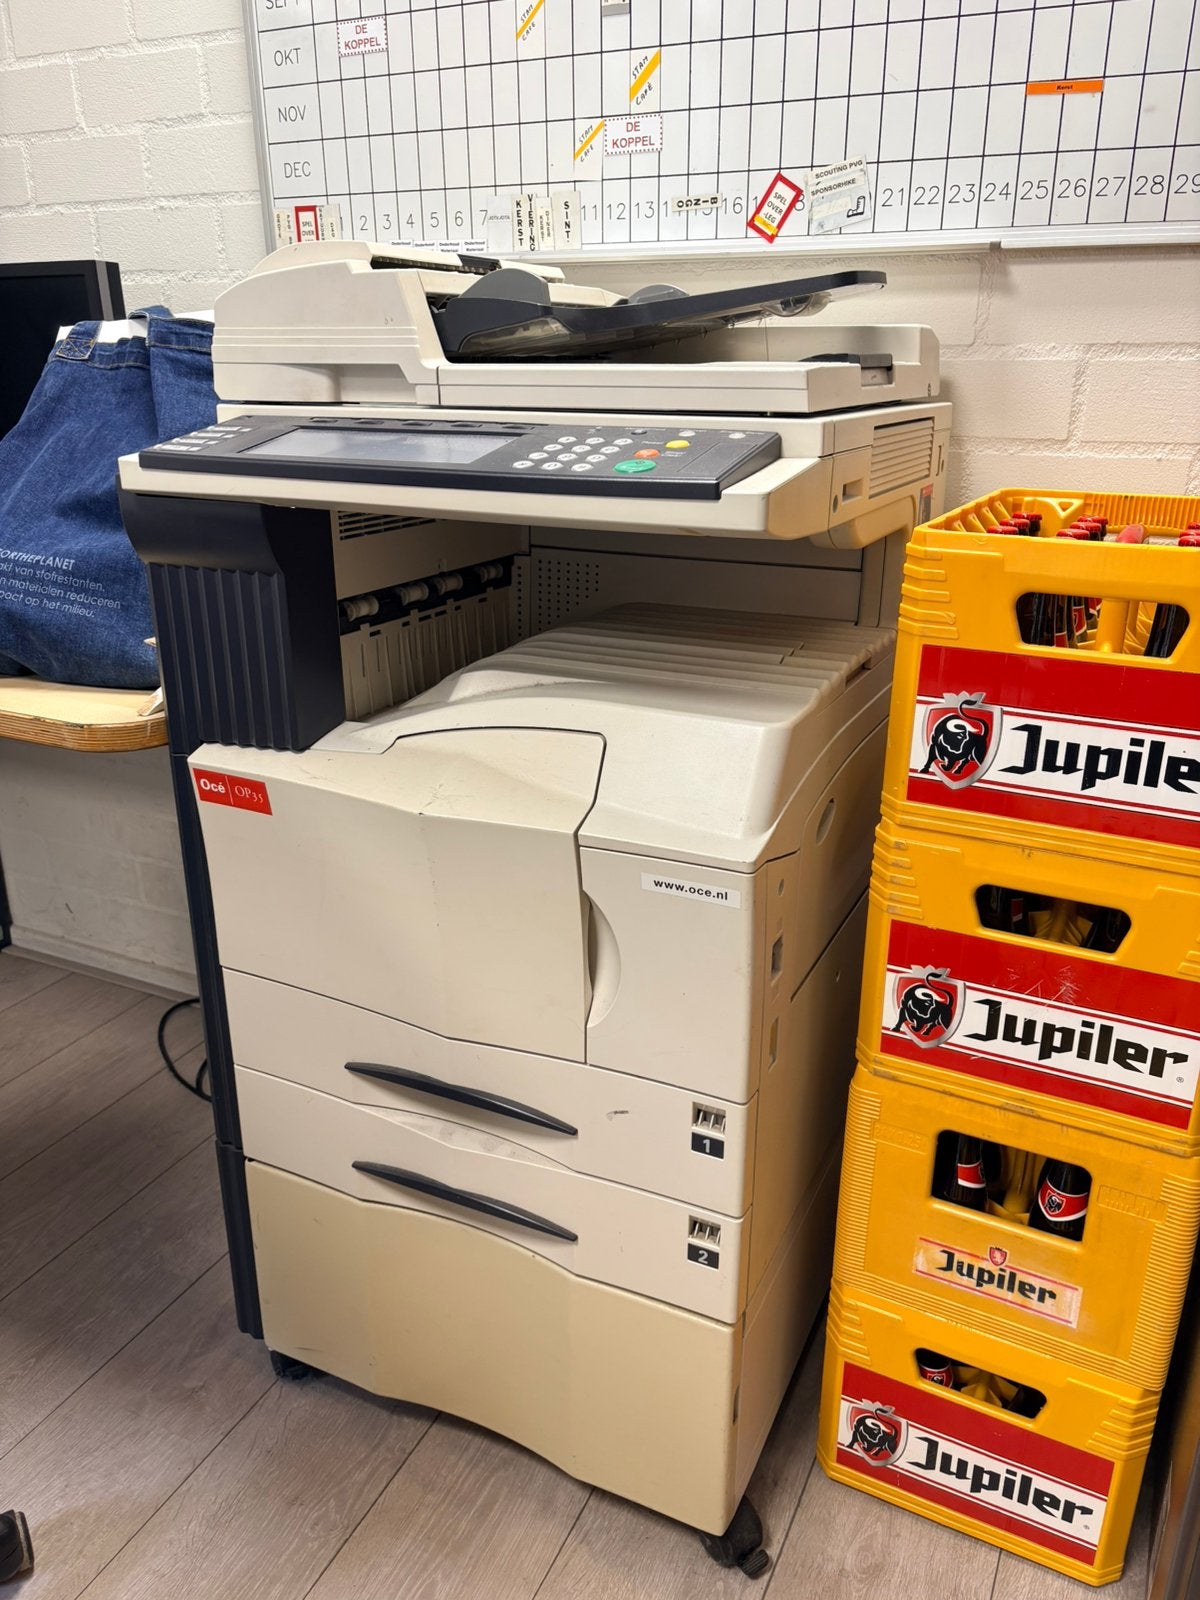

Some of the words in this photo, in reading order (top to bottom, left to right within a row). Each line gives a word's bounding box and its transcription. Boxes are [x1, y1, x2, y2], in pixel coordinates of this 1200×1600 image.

[355, 24, 368, 35] DE
[344, 37, 381, 50] KOPPEL
[274, 48, 301, 66] OKT
[631, 56, 649, 79] STAM
[278, 105, 307, 123] NOV
[625, 121, 640, 133] DE
[611, 135, 655, 149] KOPPEL
[284, 161, 311, 179] DEC
[814, 164, 848, 179] SCOUTING
[848, 159, 863, 169] PVG
[810, 177, 857, 196] SPONSORHIKE
[983, 181, 1011, 202] 24
[1020, 180, 1048, 200] 25
[1057, 178, 1087, 198] 26
[1095, 175, 1126, 197] 27
[1134, 174, 1164, 195] 28
[1174, 173, 1200, 193] 29
[676, 196, 719, 208] BINGO
[773, 192, 788, 205] SPEL
[881, 187, 904, 207] 21
[913, 185, 940, 205] 22
[948, 183, 976, 204] 23
[580, 205, 598, 220] 11
[607, 203, 626, 220] 12
[634, 202, 655, 219] 13
[722, 196, 743, 215] 16
[767, 201, 784, 216] OVER
[359, 215, 369, 231] 2
[383, 214, 392, 230] 3
[406, 213, 415, 229] 4
[430, 211, 440, 228] 5
[455, 210, 464, 227] 6
[480, 209, 489, 226] 7
[515, 200, 524, 246] KERST
[15, 566, 34, 577] van
[8, 577, 64, 598] materialen
[66, 590, 121, 609] reduceren
[25, 597, 39, 608] op
[42, 597, 60, 610] het
[200, 778, 226, 794] Océ
[234, 785, 263, 803] OP35
[653, 879, 728, 901] www.oce.nl
[964, 998, 1189, 1079] Jupiler
[702, 1138, 711, 1153] 1
[698, 1249, 709, 1264] 2
[936, 1249, 1057, 1304] Jupiler
[906, 1435, 1094, 1524] Jupiler
